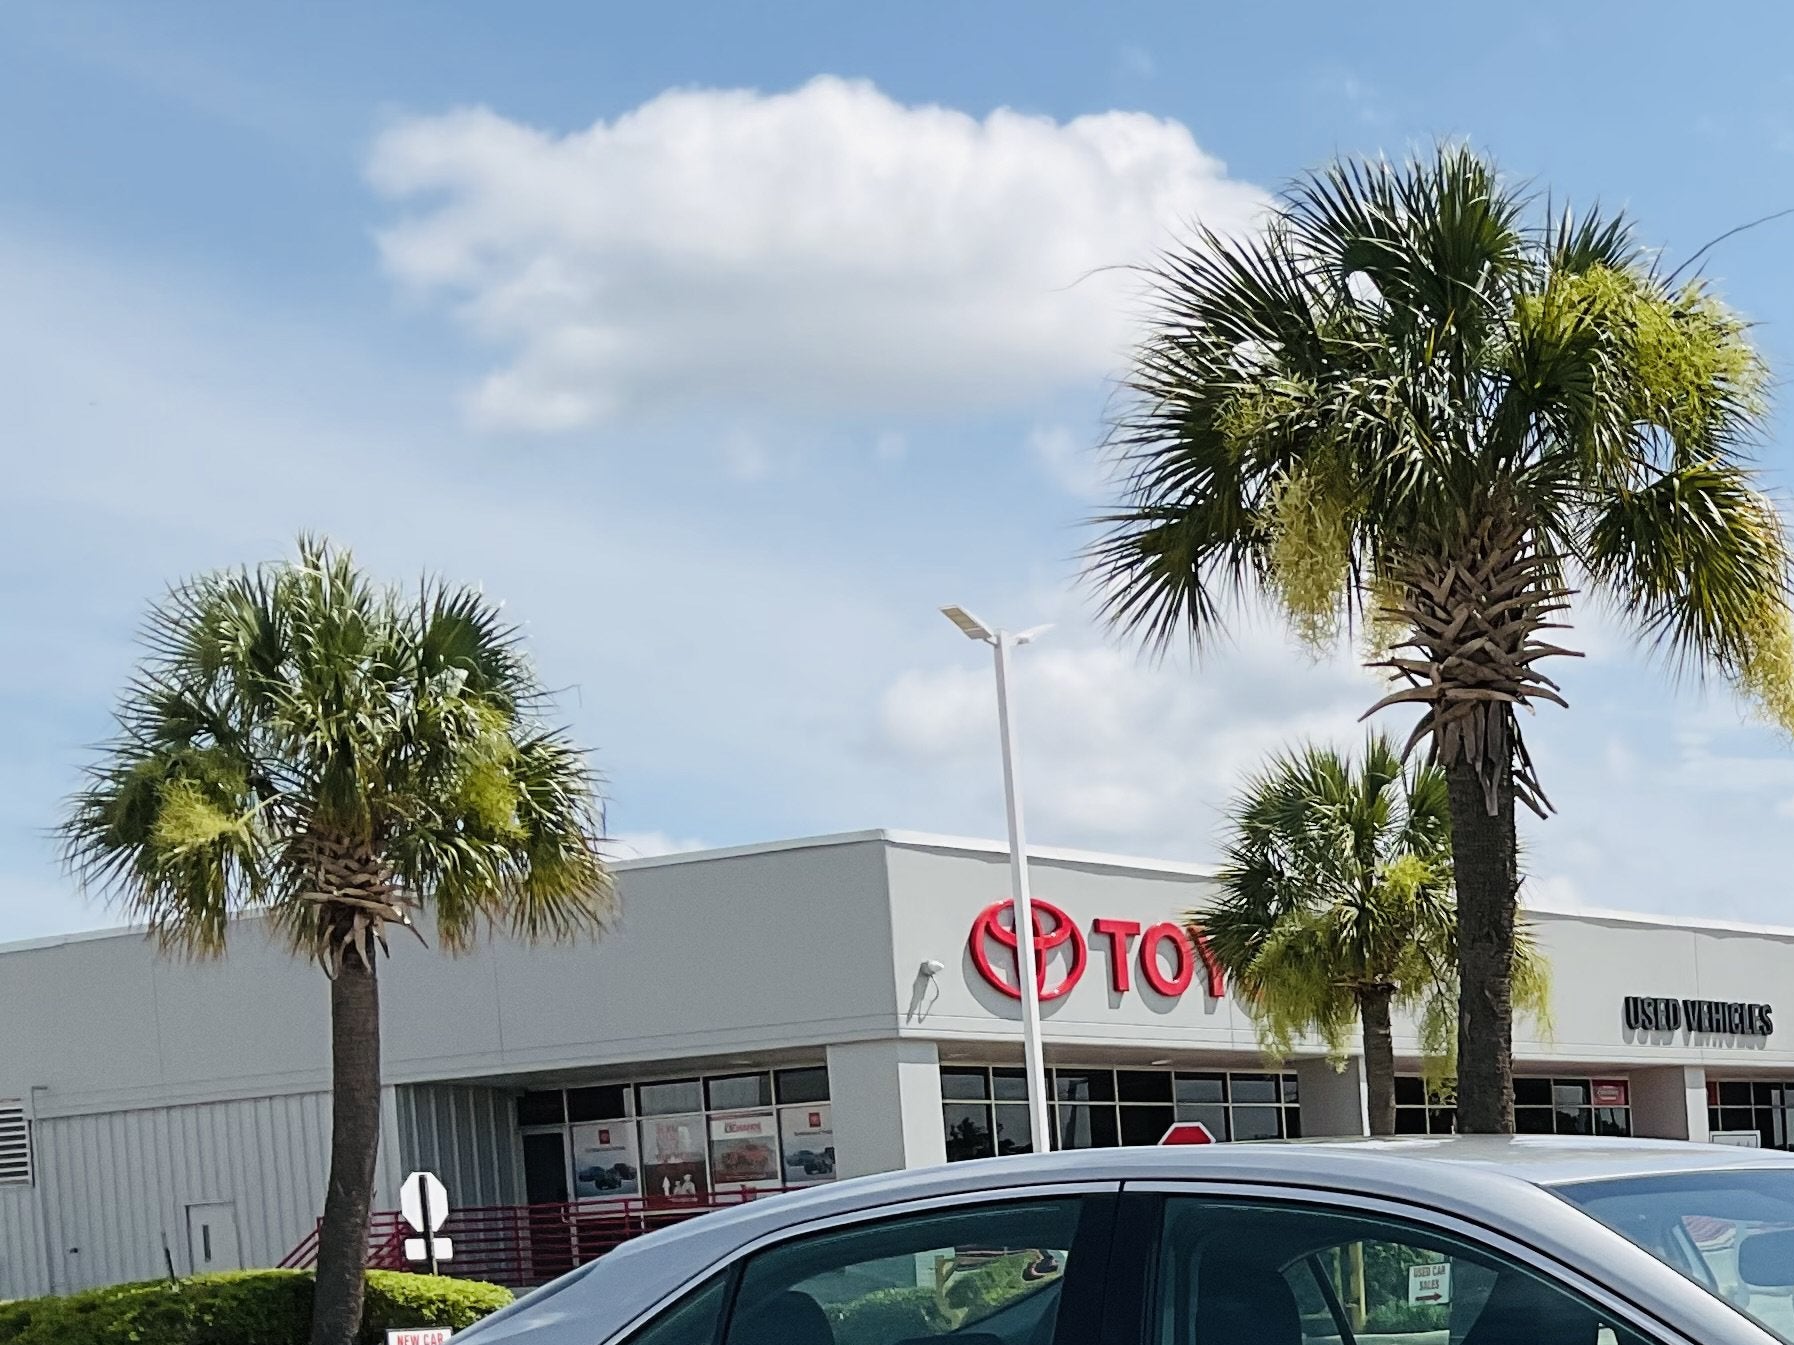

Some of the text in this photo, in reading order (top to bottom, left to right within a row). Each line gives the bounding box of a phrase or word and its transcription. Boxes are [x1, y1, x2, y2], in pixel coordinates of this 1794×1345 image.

[1624, 996, 1774, 1036] USED VEHICLES
[1413, 1265, 1446, 1278] USED CAR
[1419, 1279, 1440, 1291] SALES
